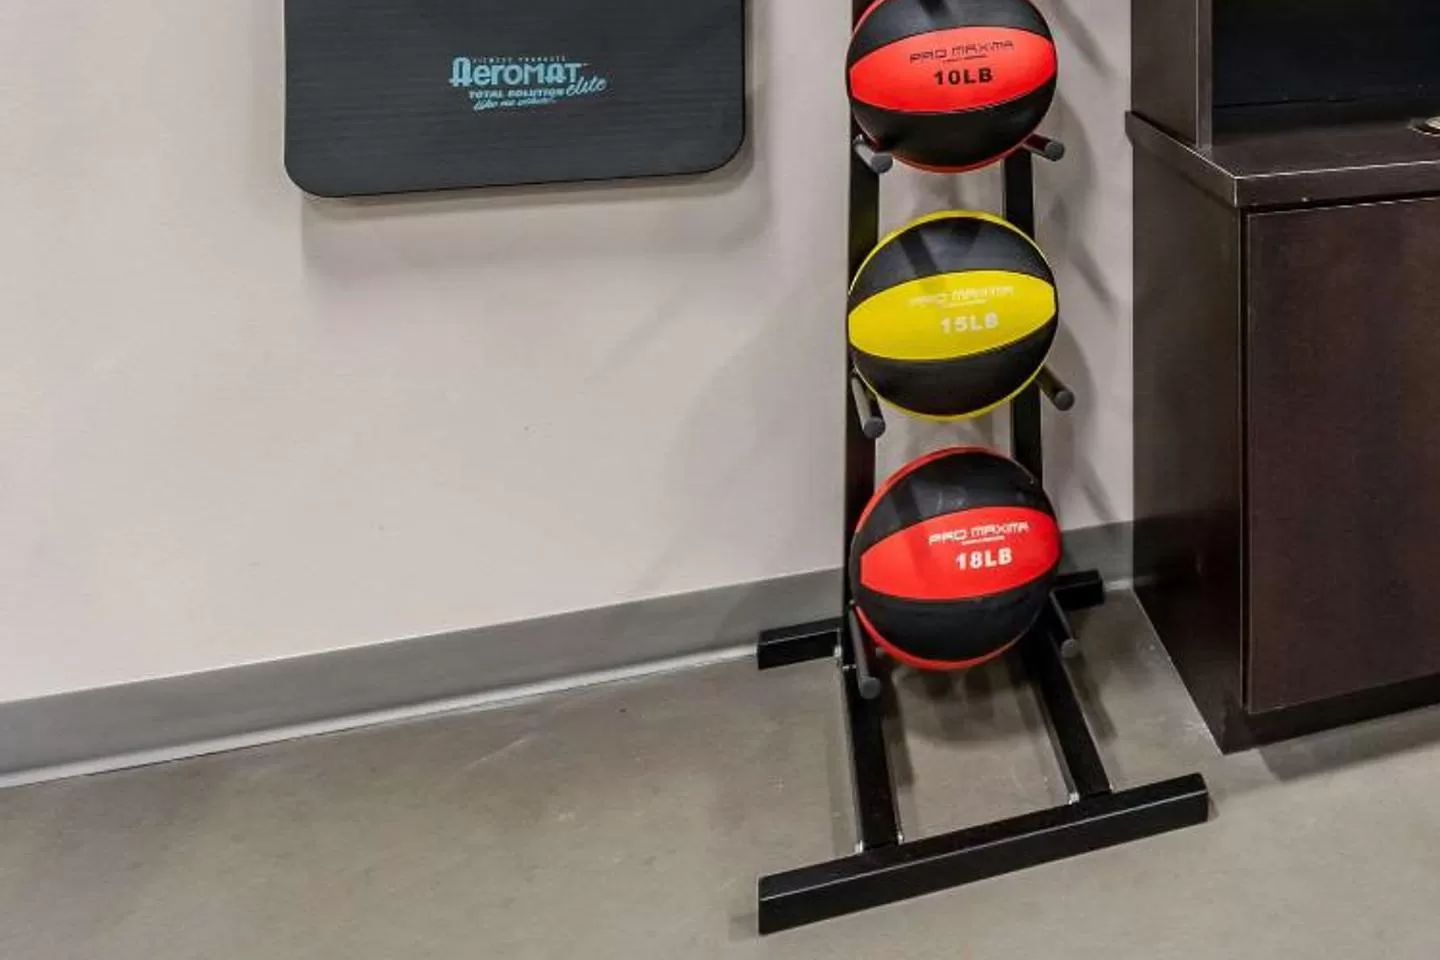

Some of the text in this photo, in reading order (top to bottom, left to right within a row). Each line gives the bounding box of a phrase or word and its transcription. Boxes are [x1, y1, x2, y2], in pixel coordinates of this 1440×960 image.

[909, 49, 947, 64] PRO
[934, 67, 993, 85] 10LB
[940, 312, 999, 334] 15LB
[928, 529, 968, 546] PRO
[955, 547, 1013, 570] 18LB
